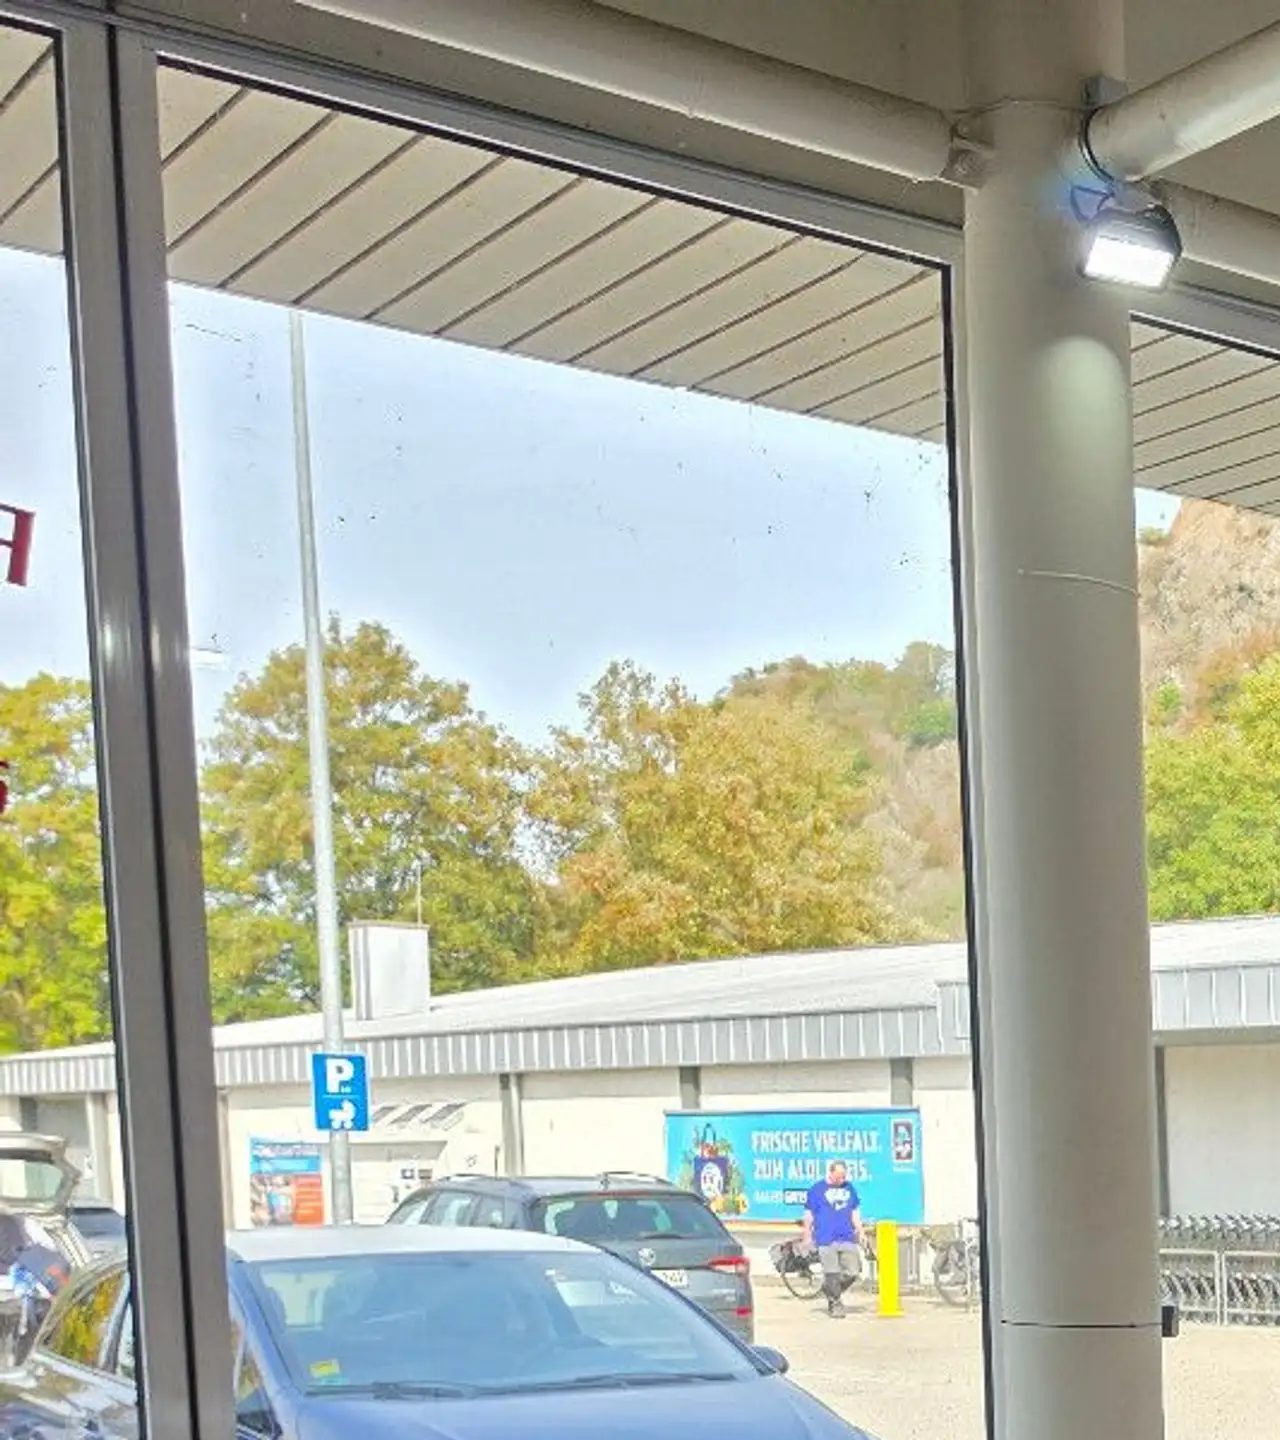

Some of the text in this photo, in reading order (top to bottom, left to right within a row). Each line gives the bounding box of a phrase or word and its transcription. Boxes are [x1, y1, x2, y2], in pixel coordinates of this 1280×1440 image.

[325, 1057, 355, 1094] P
[751, 1129, 809, 1153] FRISCHE
[753, 1160, 784, 1182] ZUM
